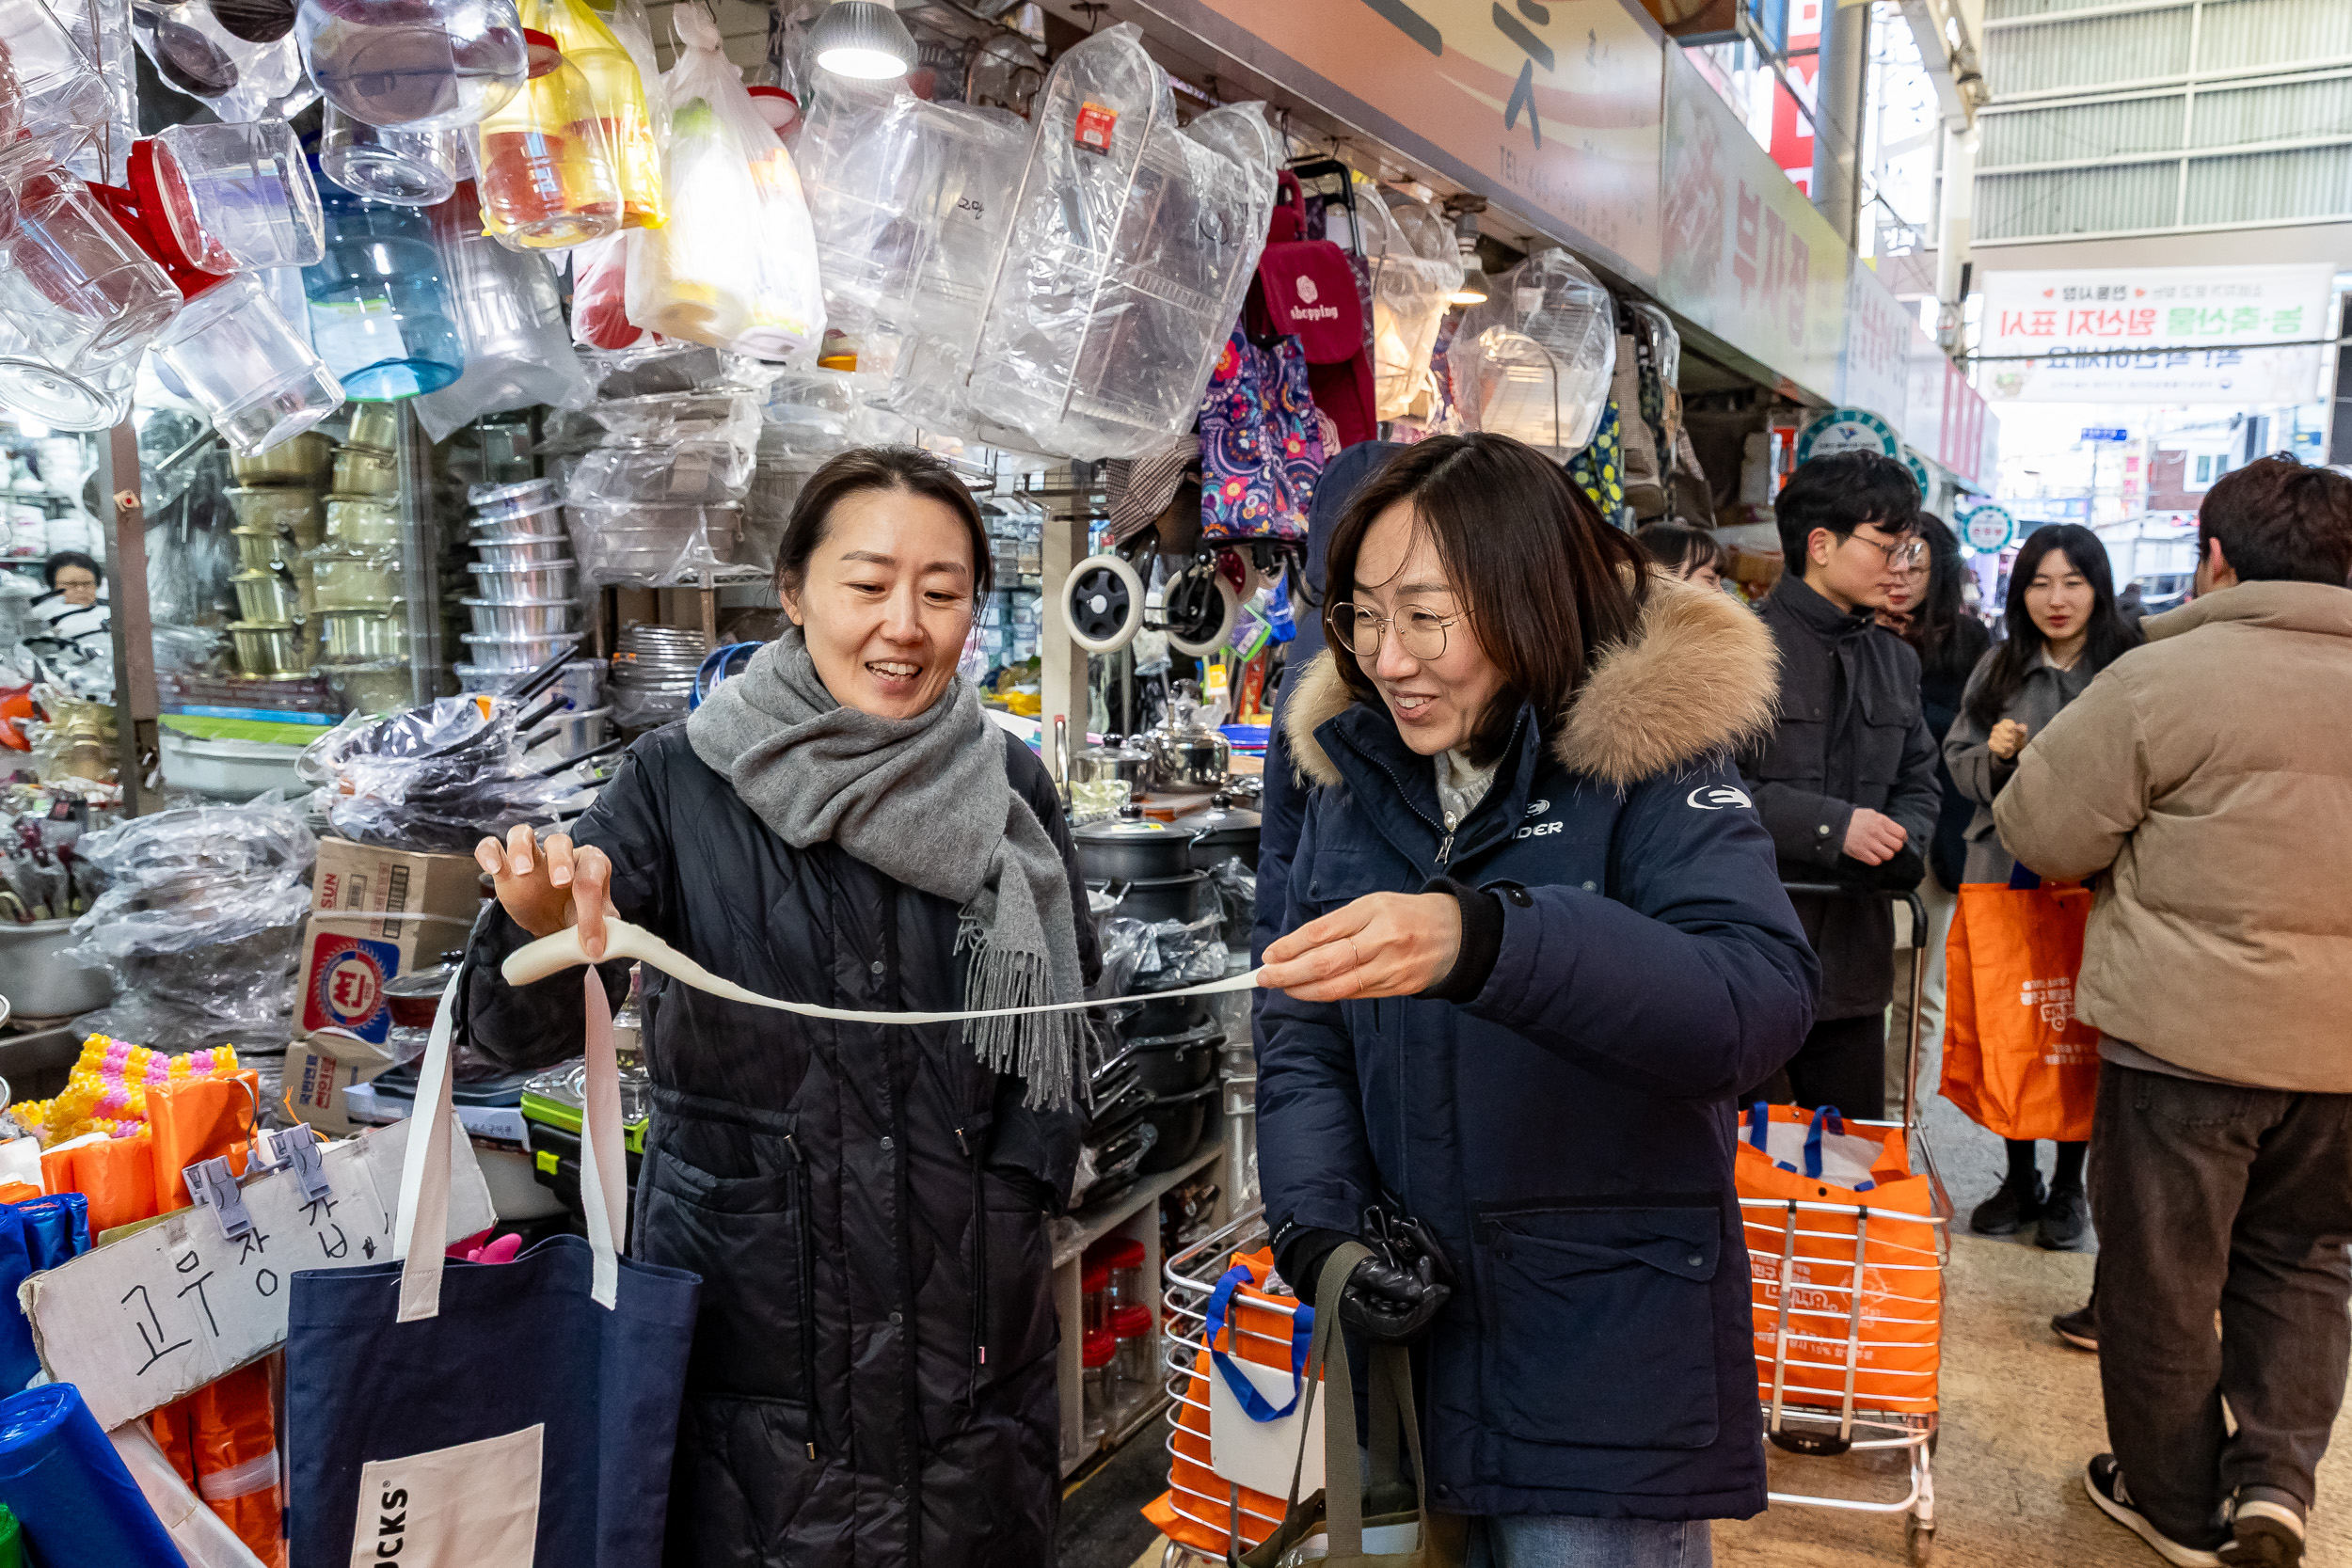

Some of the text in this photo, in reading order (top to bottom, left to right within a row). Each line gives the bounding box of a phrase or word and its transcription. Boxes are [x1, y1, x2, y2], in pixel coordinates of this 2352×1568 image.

[1290, 304, 1339, 321] shopping
[320, 873, 339, 909] SUN
[121, 1199, 348, 1376] 고무장갑
